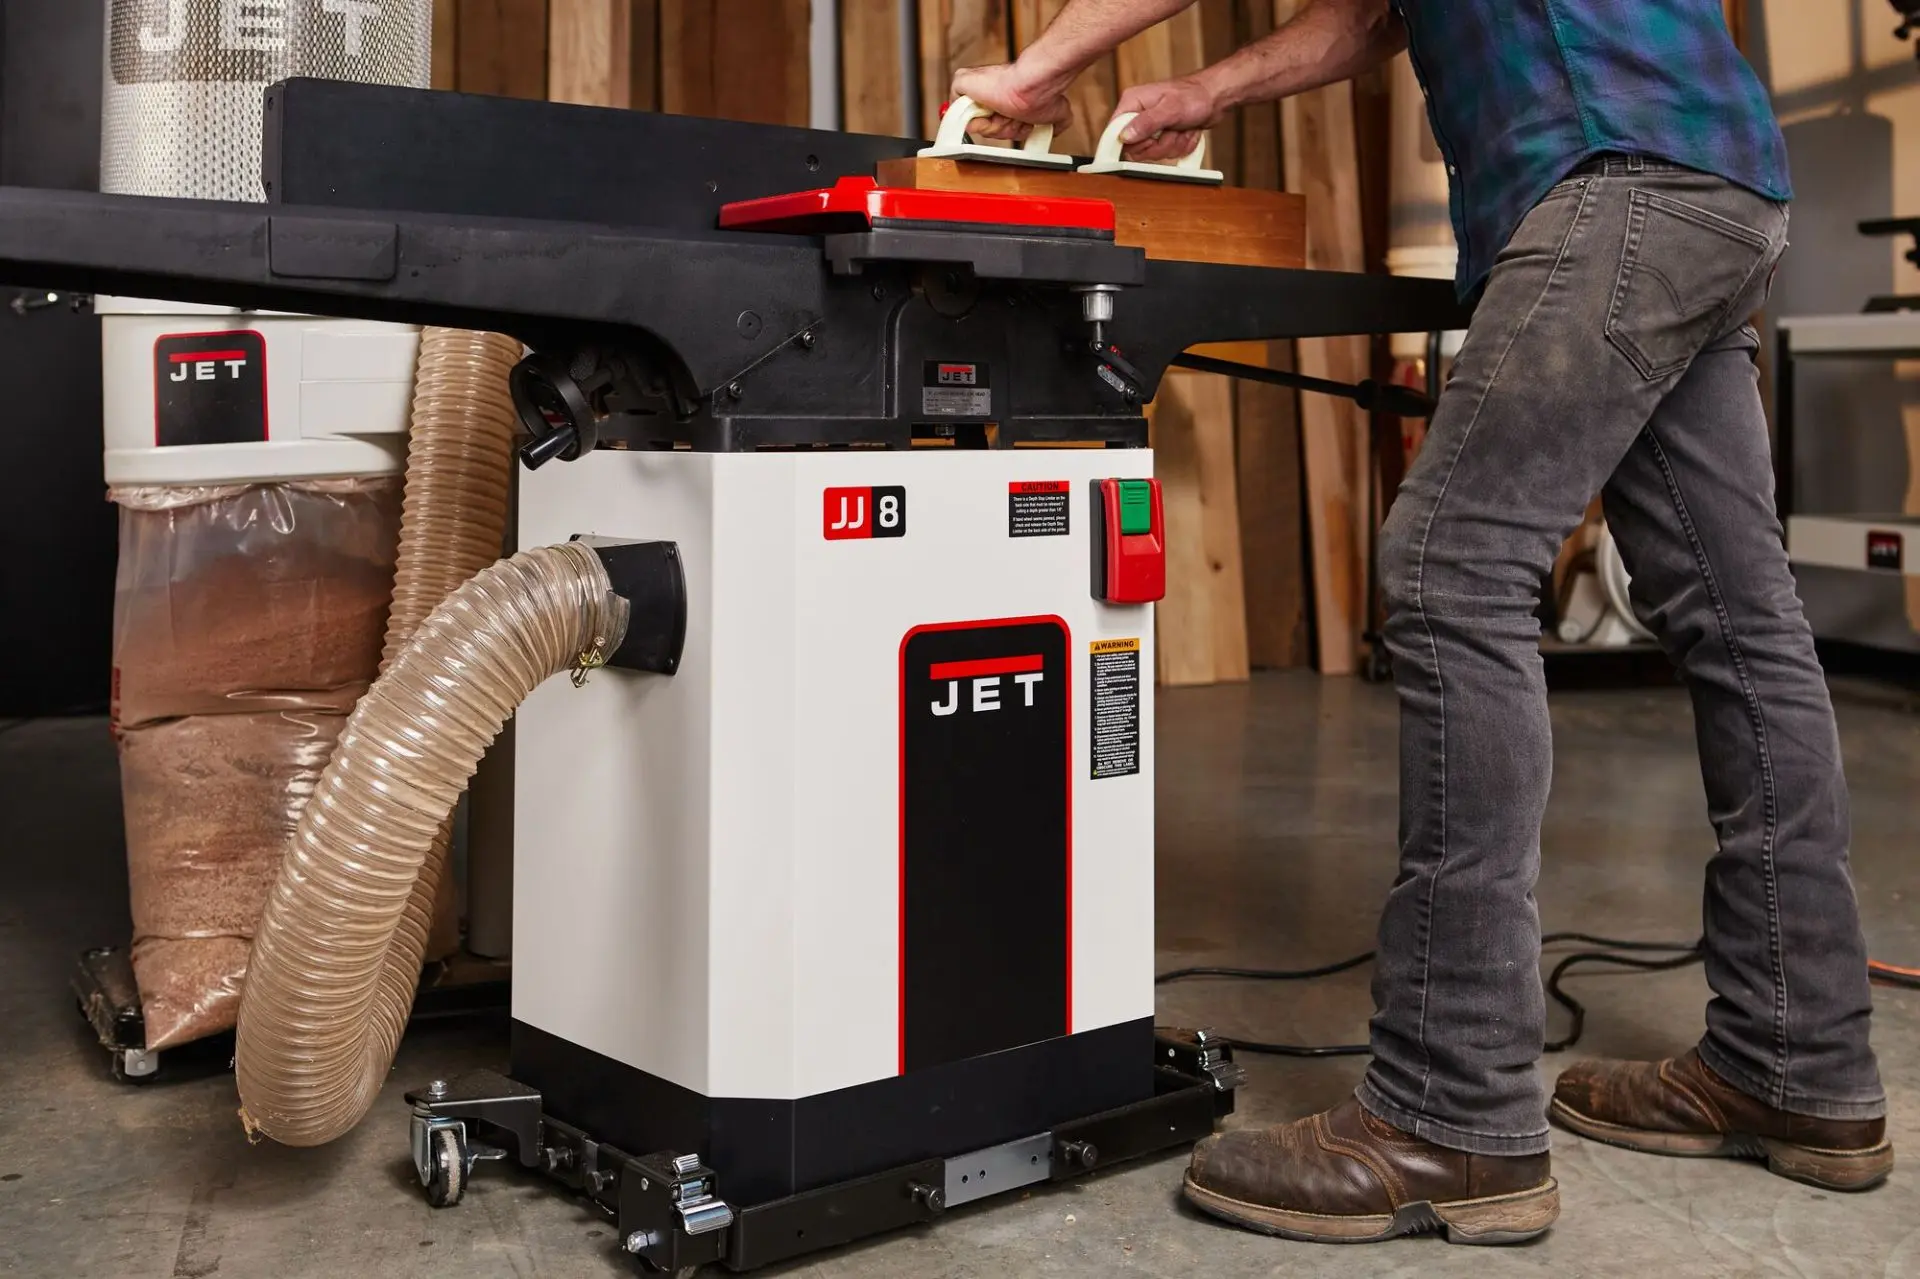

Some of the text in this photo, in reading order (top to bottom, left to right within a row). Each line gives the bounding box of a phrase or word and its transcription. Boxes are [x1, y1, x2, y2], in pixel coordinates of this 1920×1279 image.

[138, 0, 384, 57] JET
[170, 360, 246, 381] JET
[942, 372, 972, 381] JET
[1021, 481, 1059, 492] CAUTION
[831, 495, 899, 529] JJ 8
[1100, 641, 1134, 650] WARNING
[931, 673, 1044, 716] JET
